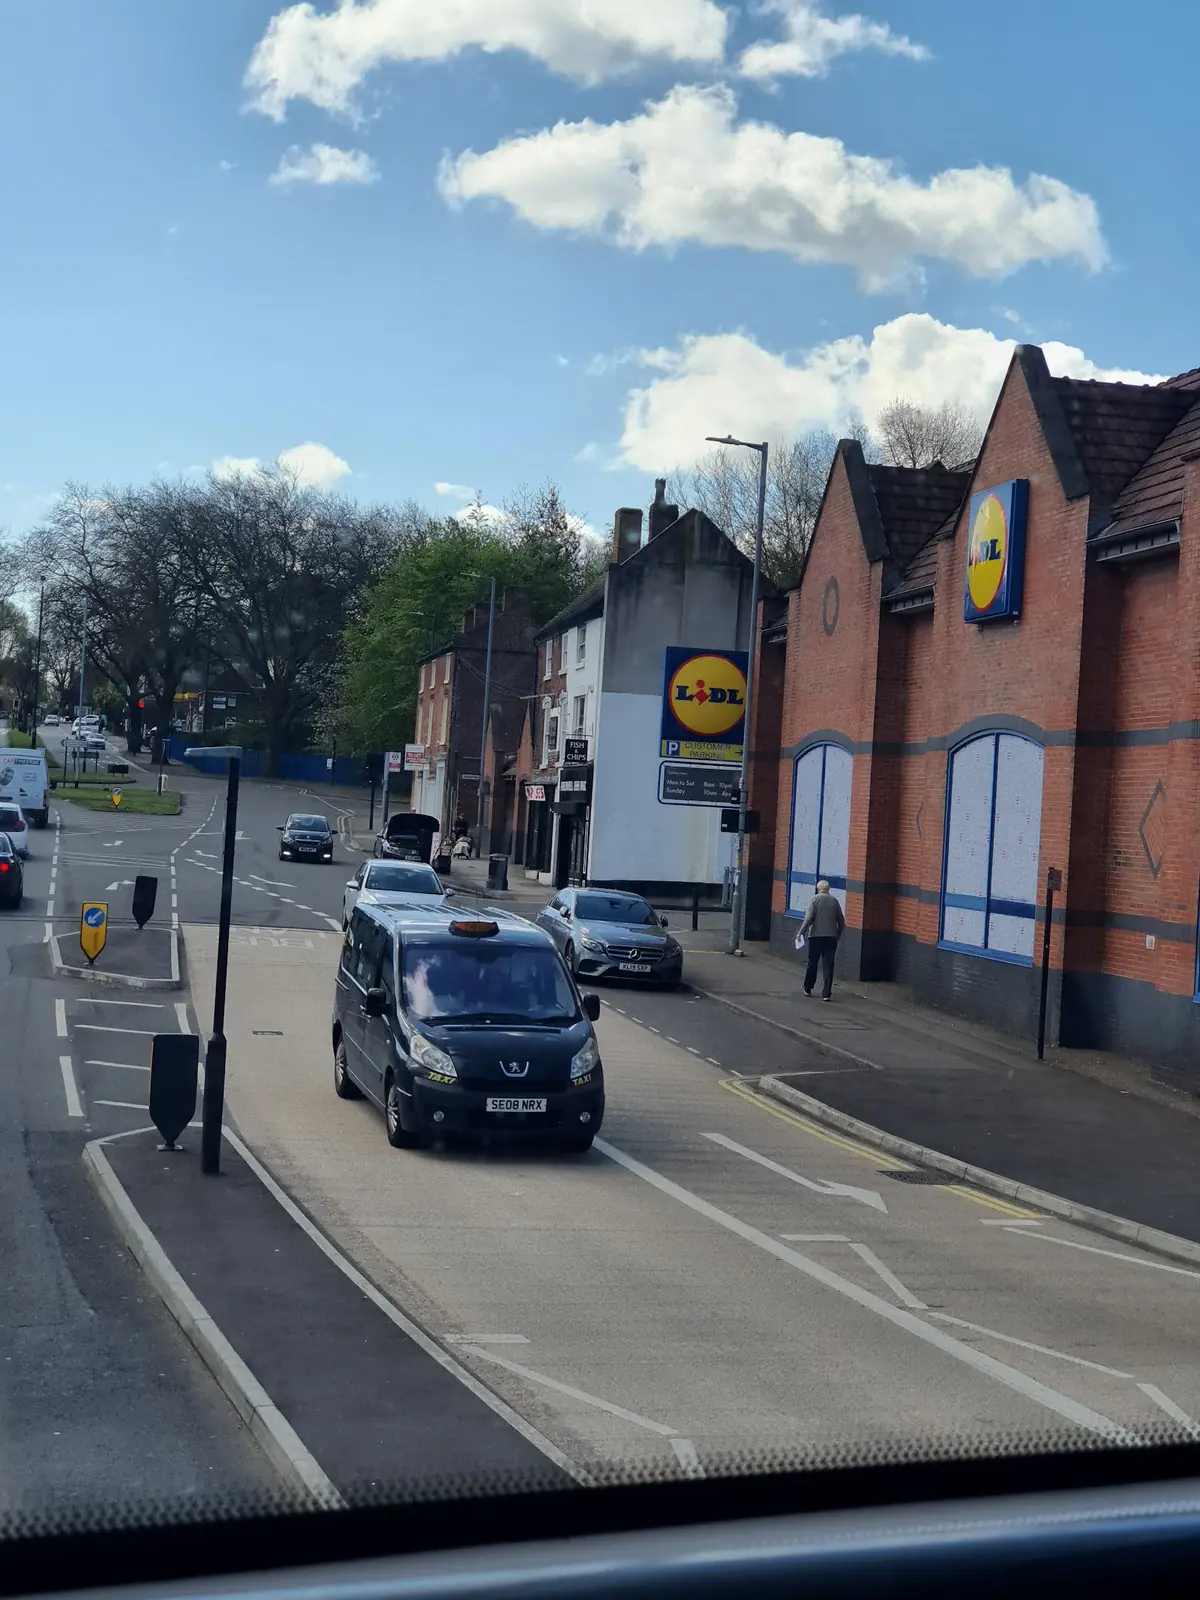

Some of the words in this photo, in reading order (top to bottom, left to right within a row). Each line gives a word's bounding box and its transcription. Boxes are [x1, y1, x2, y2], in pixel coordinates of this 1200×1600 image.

[685, 742, 731, 751] CUSTOMER
[666, 787, 686, 795] Sunday
[427, 1071, 456, 1084] TAXI
[572, 1073, 592, 1087] TAXI
[491, 1099, 519, 1110] SE08
[521, 1099, 543, 1110] NRX
